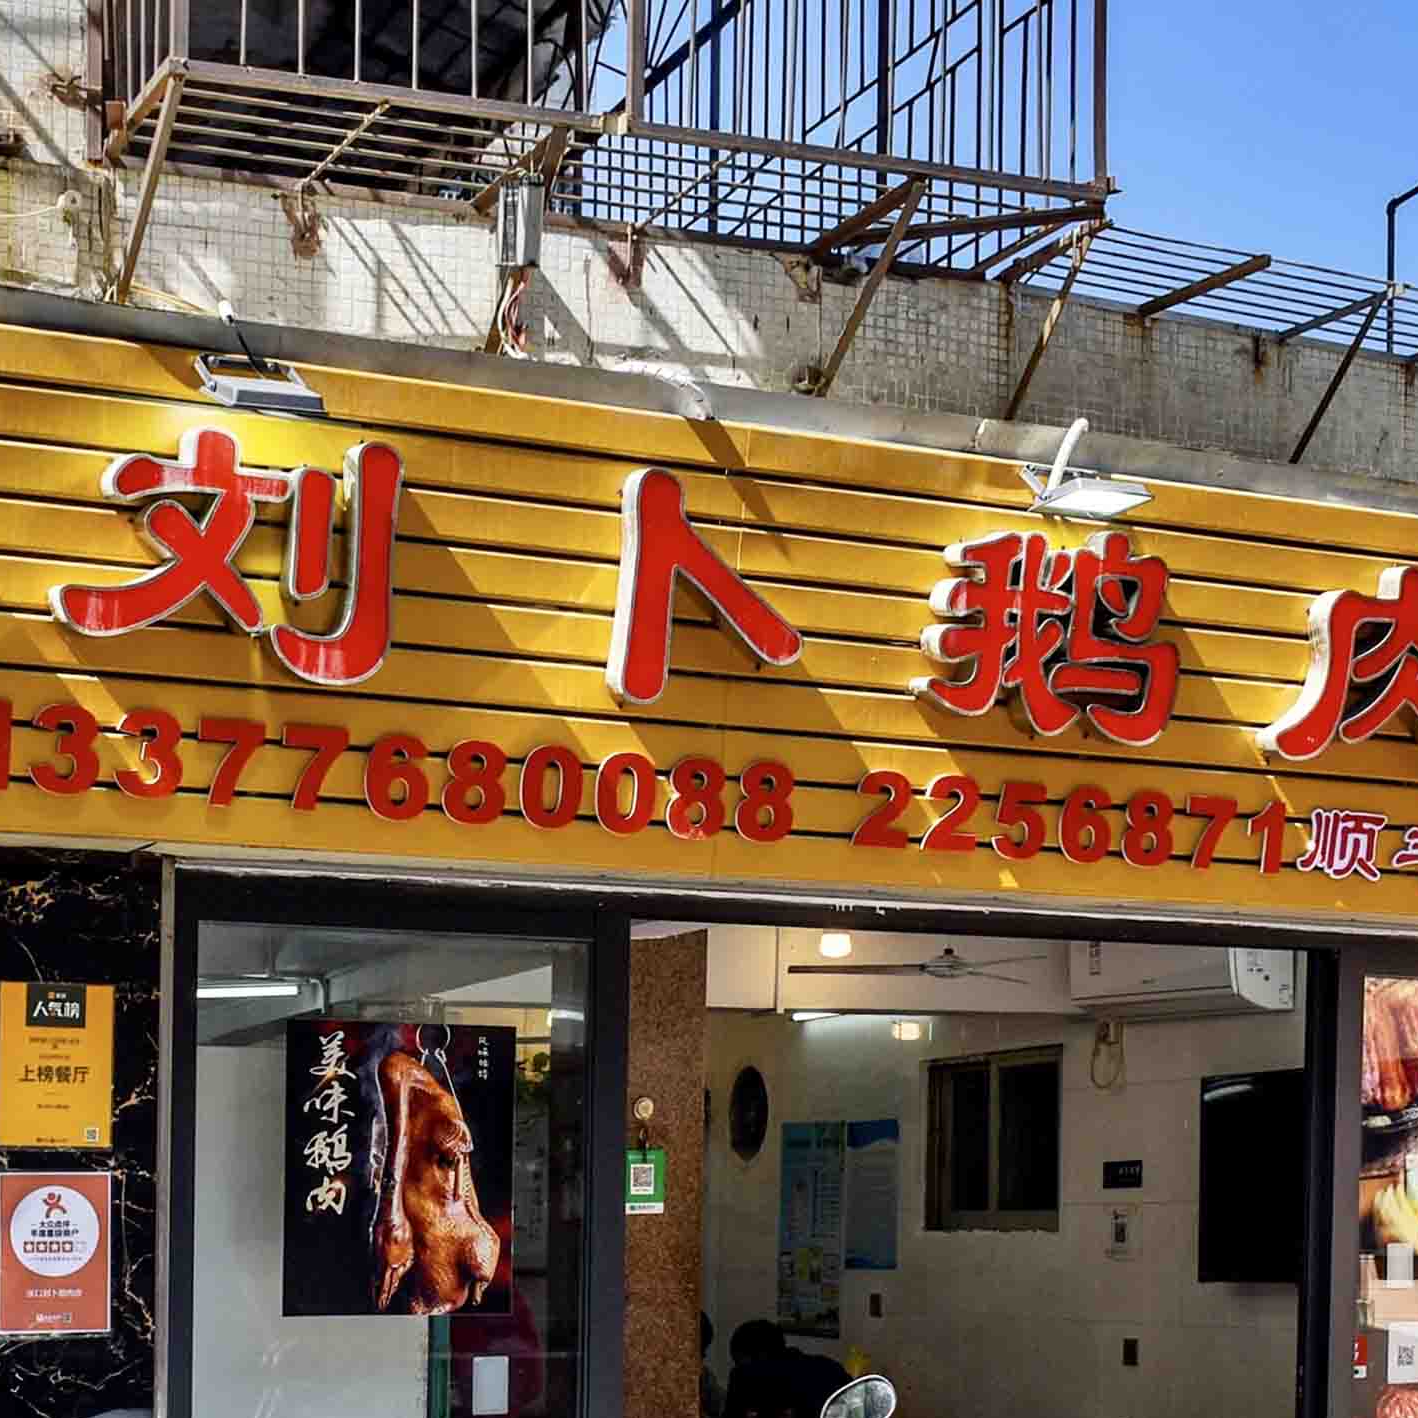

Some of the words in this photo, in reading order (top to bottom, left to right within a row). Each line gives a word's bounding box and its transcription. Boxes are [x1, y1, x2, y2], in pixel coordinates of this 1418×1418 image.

[852, 770, 1289, 876] 2256871
[19, 1064, 90, 1085] 上榜餐厅
[302, 1031, 358, 1216] 美味鹅肉
